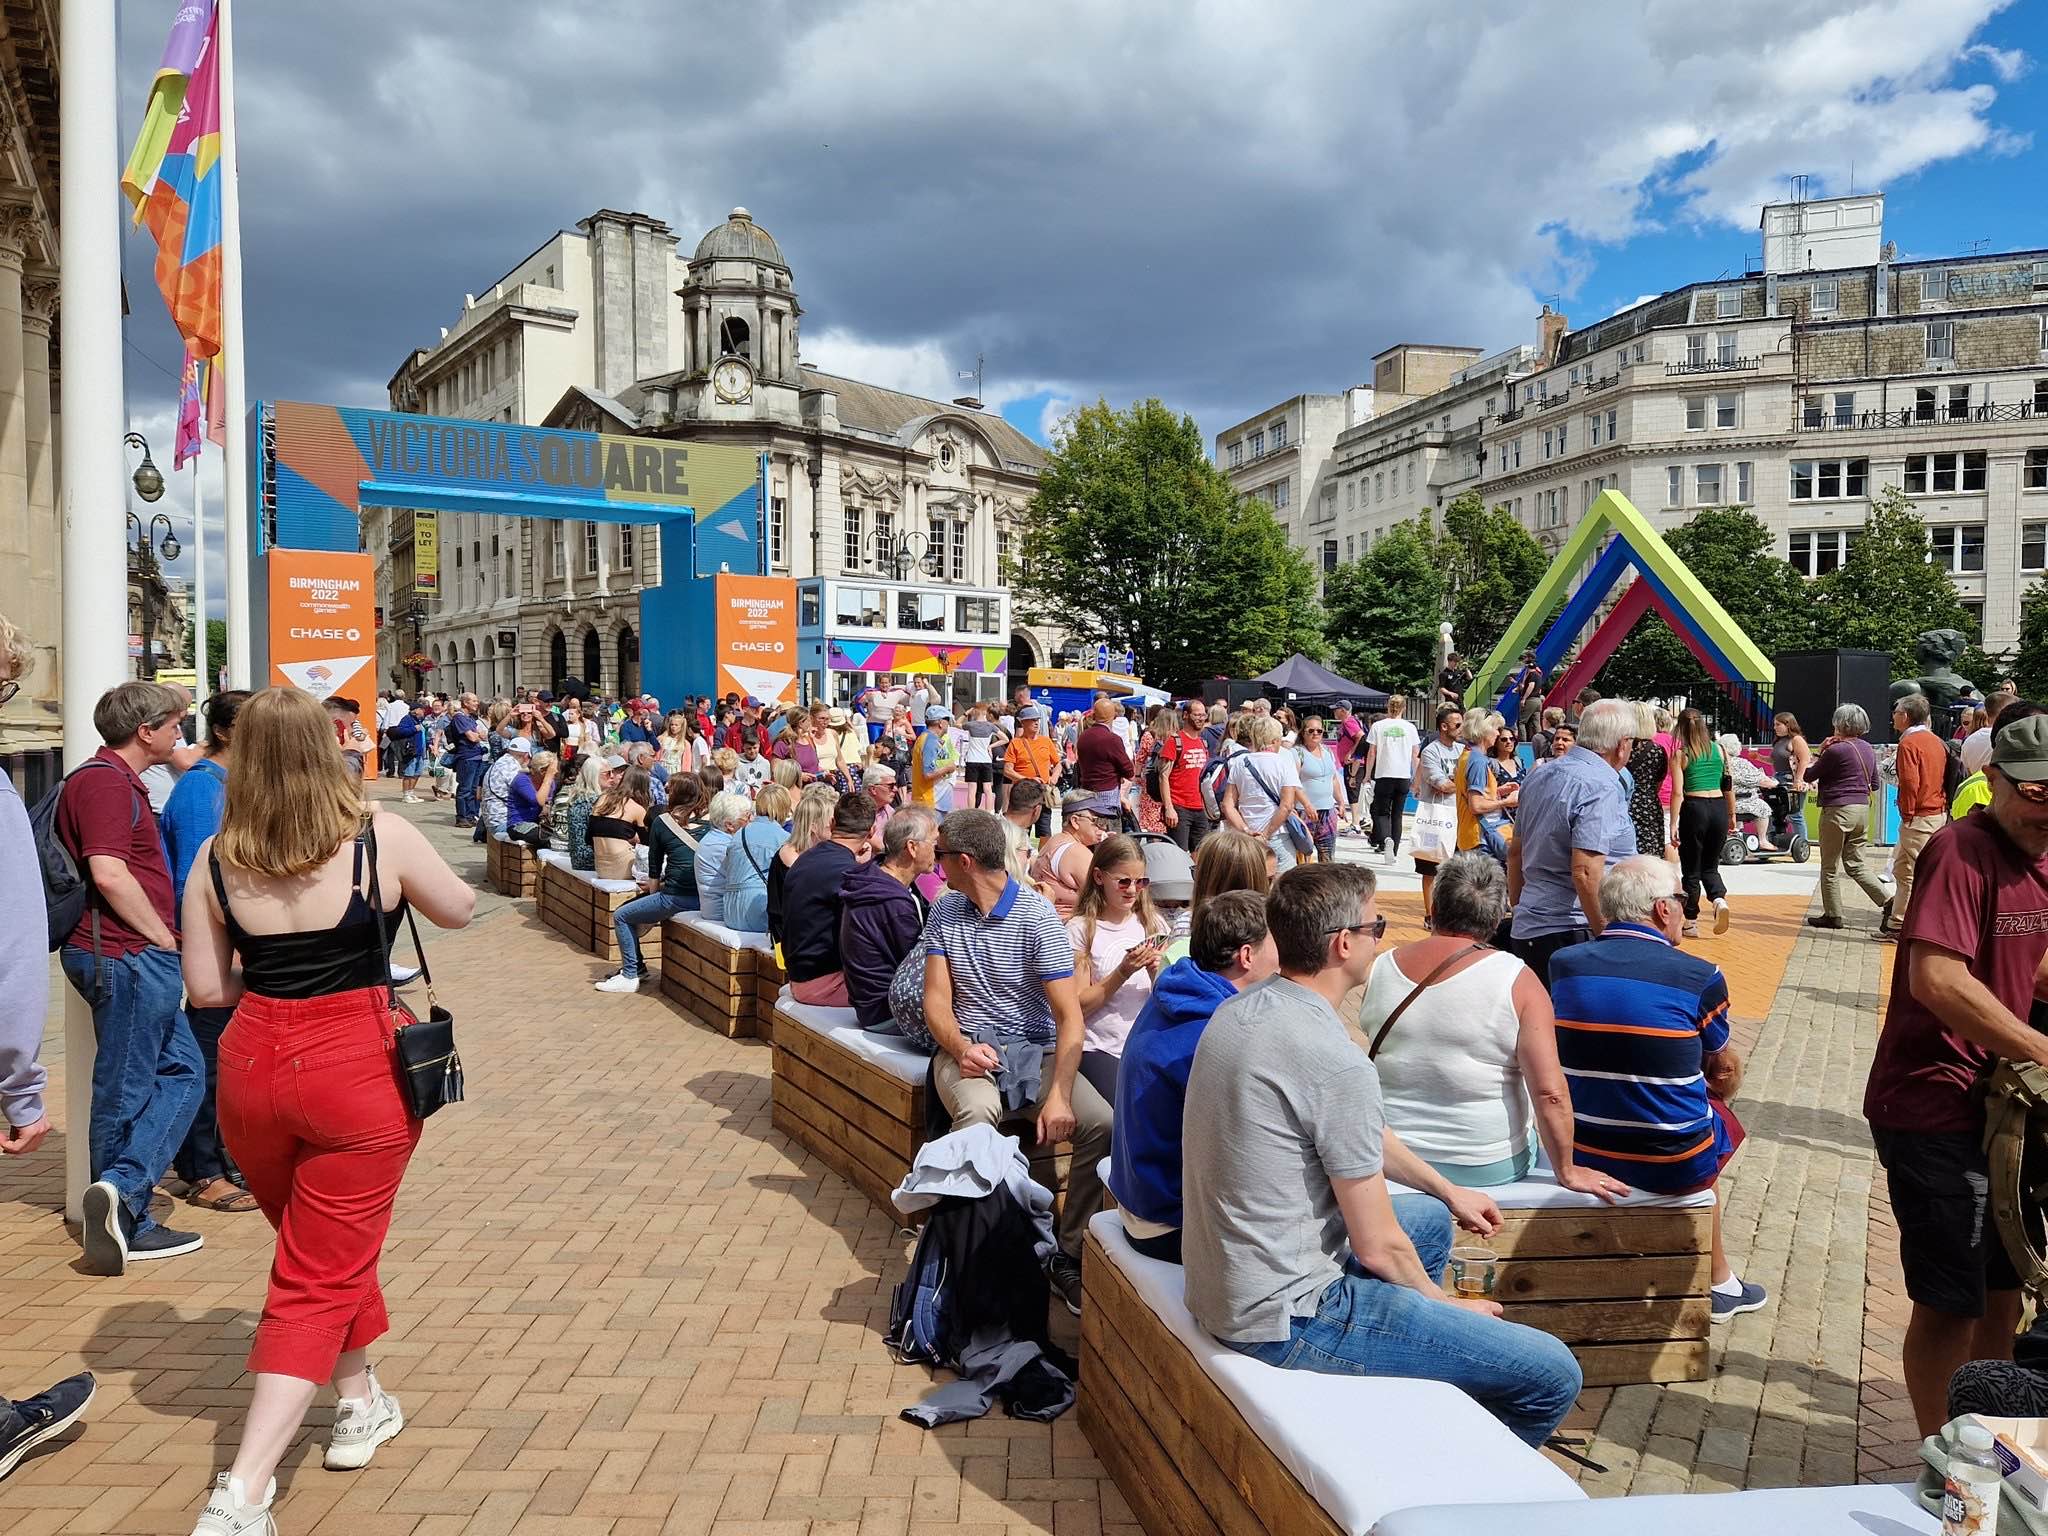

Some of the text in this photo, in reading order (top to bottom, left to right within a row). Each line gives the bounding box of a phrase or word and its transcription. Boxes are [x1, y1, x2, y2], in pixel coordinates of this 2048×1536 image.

[367, 417, 690, 497] VICTORIA SQUARE
[289, 577, 360, 591] BIRMINGHAM
[311, 589, 339, 601] 2022
[731, 598, 783, 608] BIRMINGHAM
[747, 608, 769, 618] 2022
[290, 627, 345, 639] CHASE
[732, 641, 772, 651] CHASE
[1416, 817, 1444, 827] CHASE
